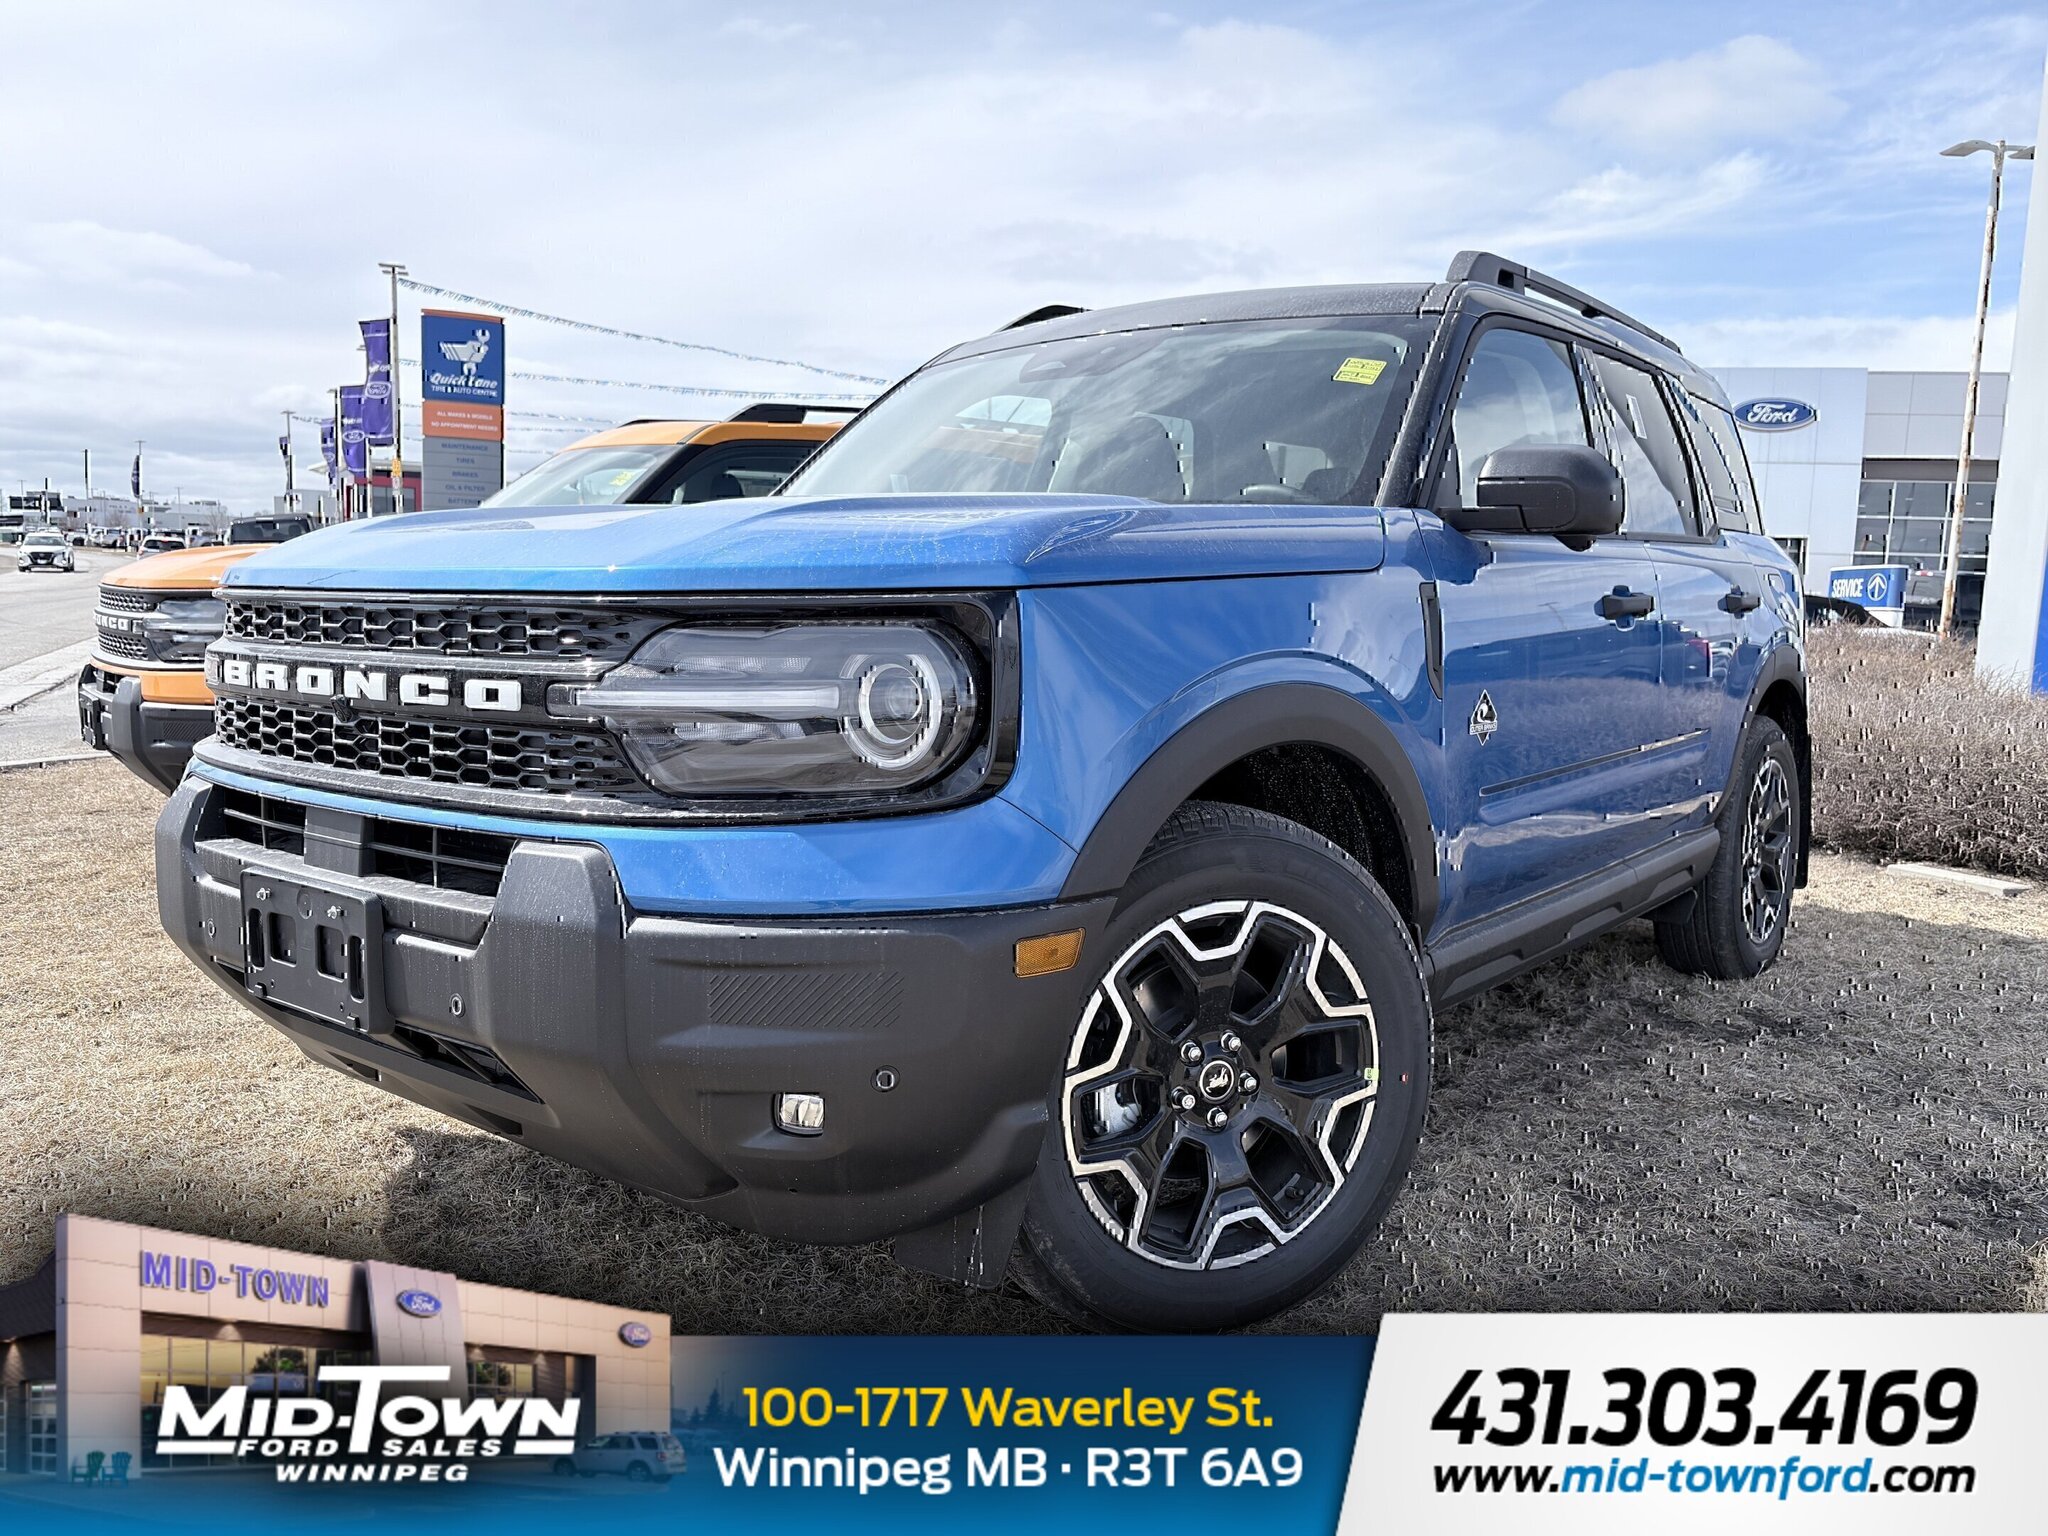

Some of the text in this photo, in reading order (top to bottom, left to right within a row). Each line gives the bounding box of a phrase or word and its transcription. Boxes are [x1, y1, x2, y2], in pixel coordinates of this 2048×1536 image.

[430, 372, 498, 389] Quick Lane
[453, 387, 471, 395] AUTO
[472, 388, 498, 397] CENTRE
[1747, 403, 1798, 423] Ford
[440, 422, 477, 430] APPOINTMENT
[441, 443, 489, 451] MAINTENANCE
[456, 457, 475, 465] TIRES
[1832, 578, 1864, 598] SERVICE
[223, 659, 522, 711] BRONCO
